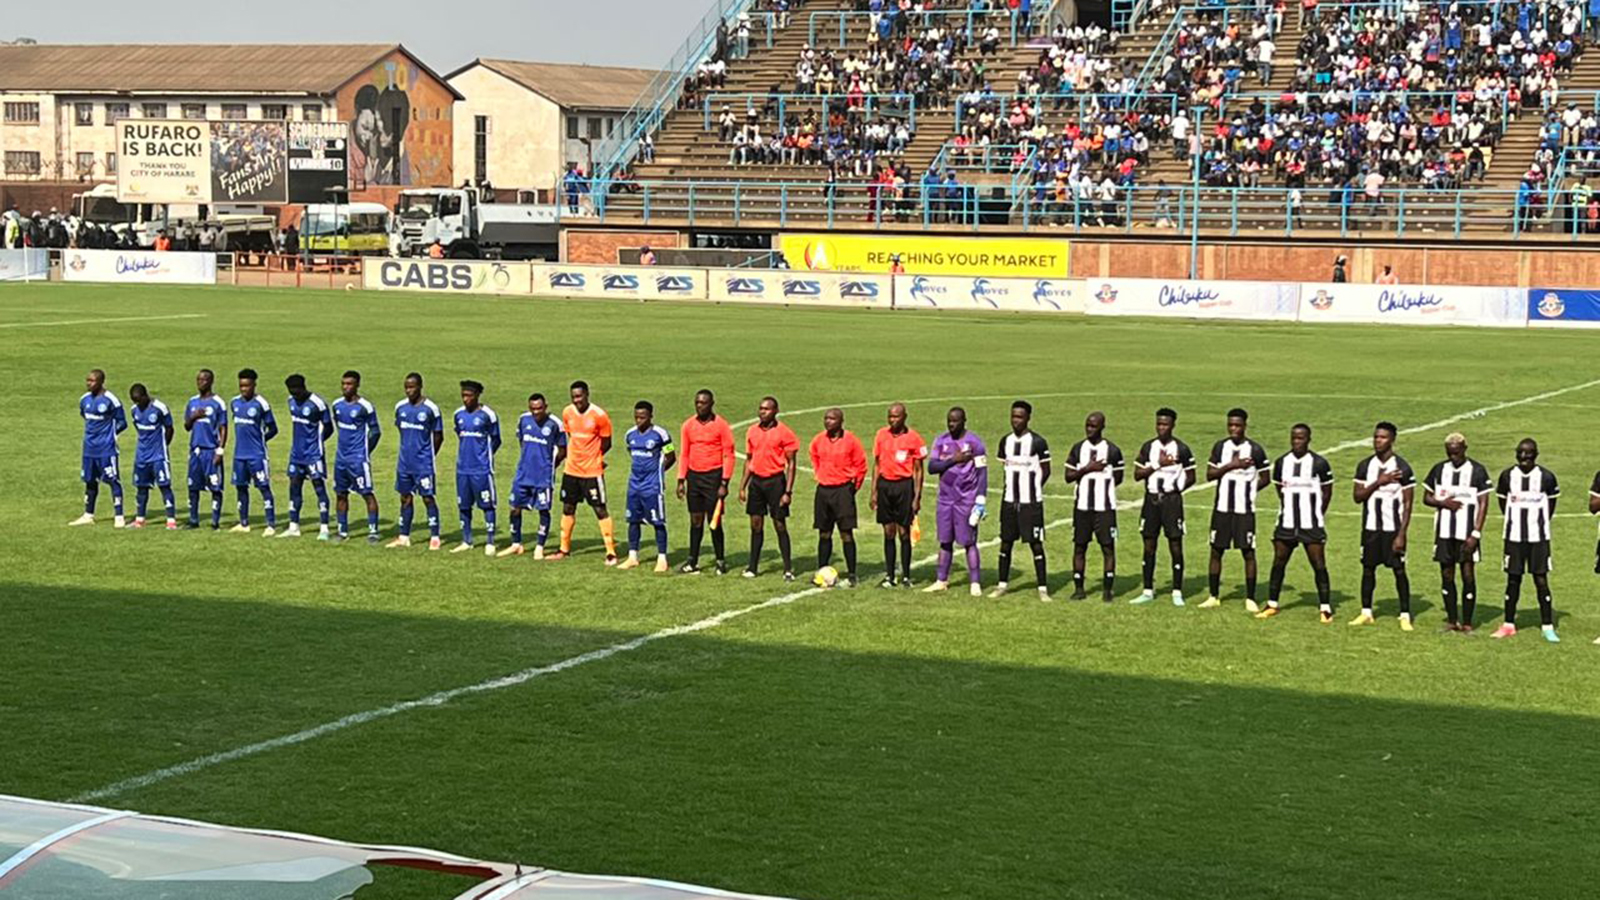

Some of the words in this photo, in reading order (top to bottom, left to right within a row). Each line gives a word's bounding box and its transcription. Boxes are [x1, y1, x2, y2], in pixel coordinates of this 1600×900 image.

[124, 125, 201, 140] RUFARO
[123, 141, 139, 156] IS
[145, 142, 202, 157] BACK!
[219, 162, 252, 189] Fans
[867, 252, 944, 266] REACHING
[947, 253, 990, 266] YOUR
[993, 254, 1058, 268] MARKET
[380, 261, 472, 289] CABS
